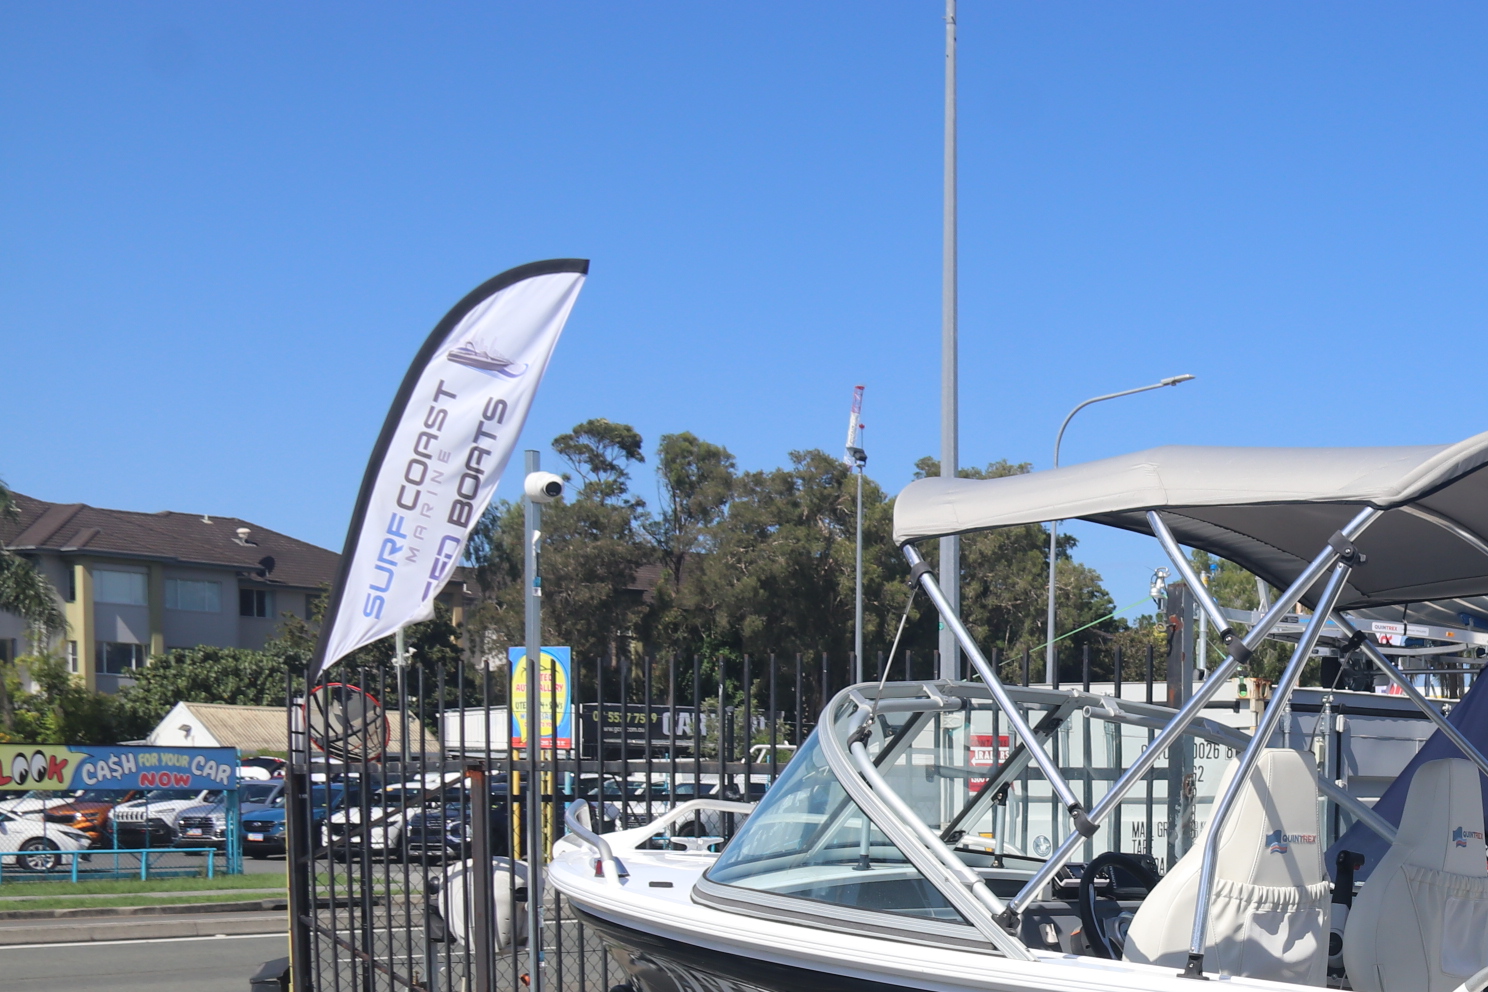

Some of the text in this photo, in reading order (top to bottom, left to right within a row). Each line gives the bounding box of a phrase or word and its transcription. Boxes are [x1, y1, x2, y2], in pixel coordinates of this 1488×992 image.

[447, 397, 508, 529] BOATS
[405, 450, 451, 563] MARINE
[82, 753, 137, 785] CA$H
[139, 754, 160, 767] FOR
[161, 753, 189, 767] YOUR
[191, 755, 232, 785] CAR
[139, 771, 191, 787] NOW
[1282, 834, 1317, 843] QUINTREX
